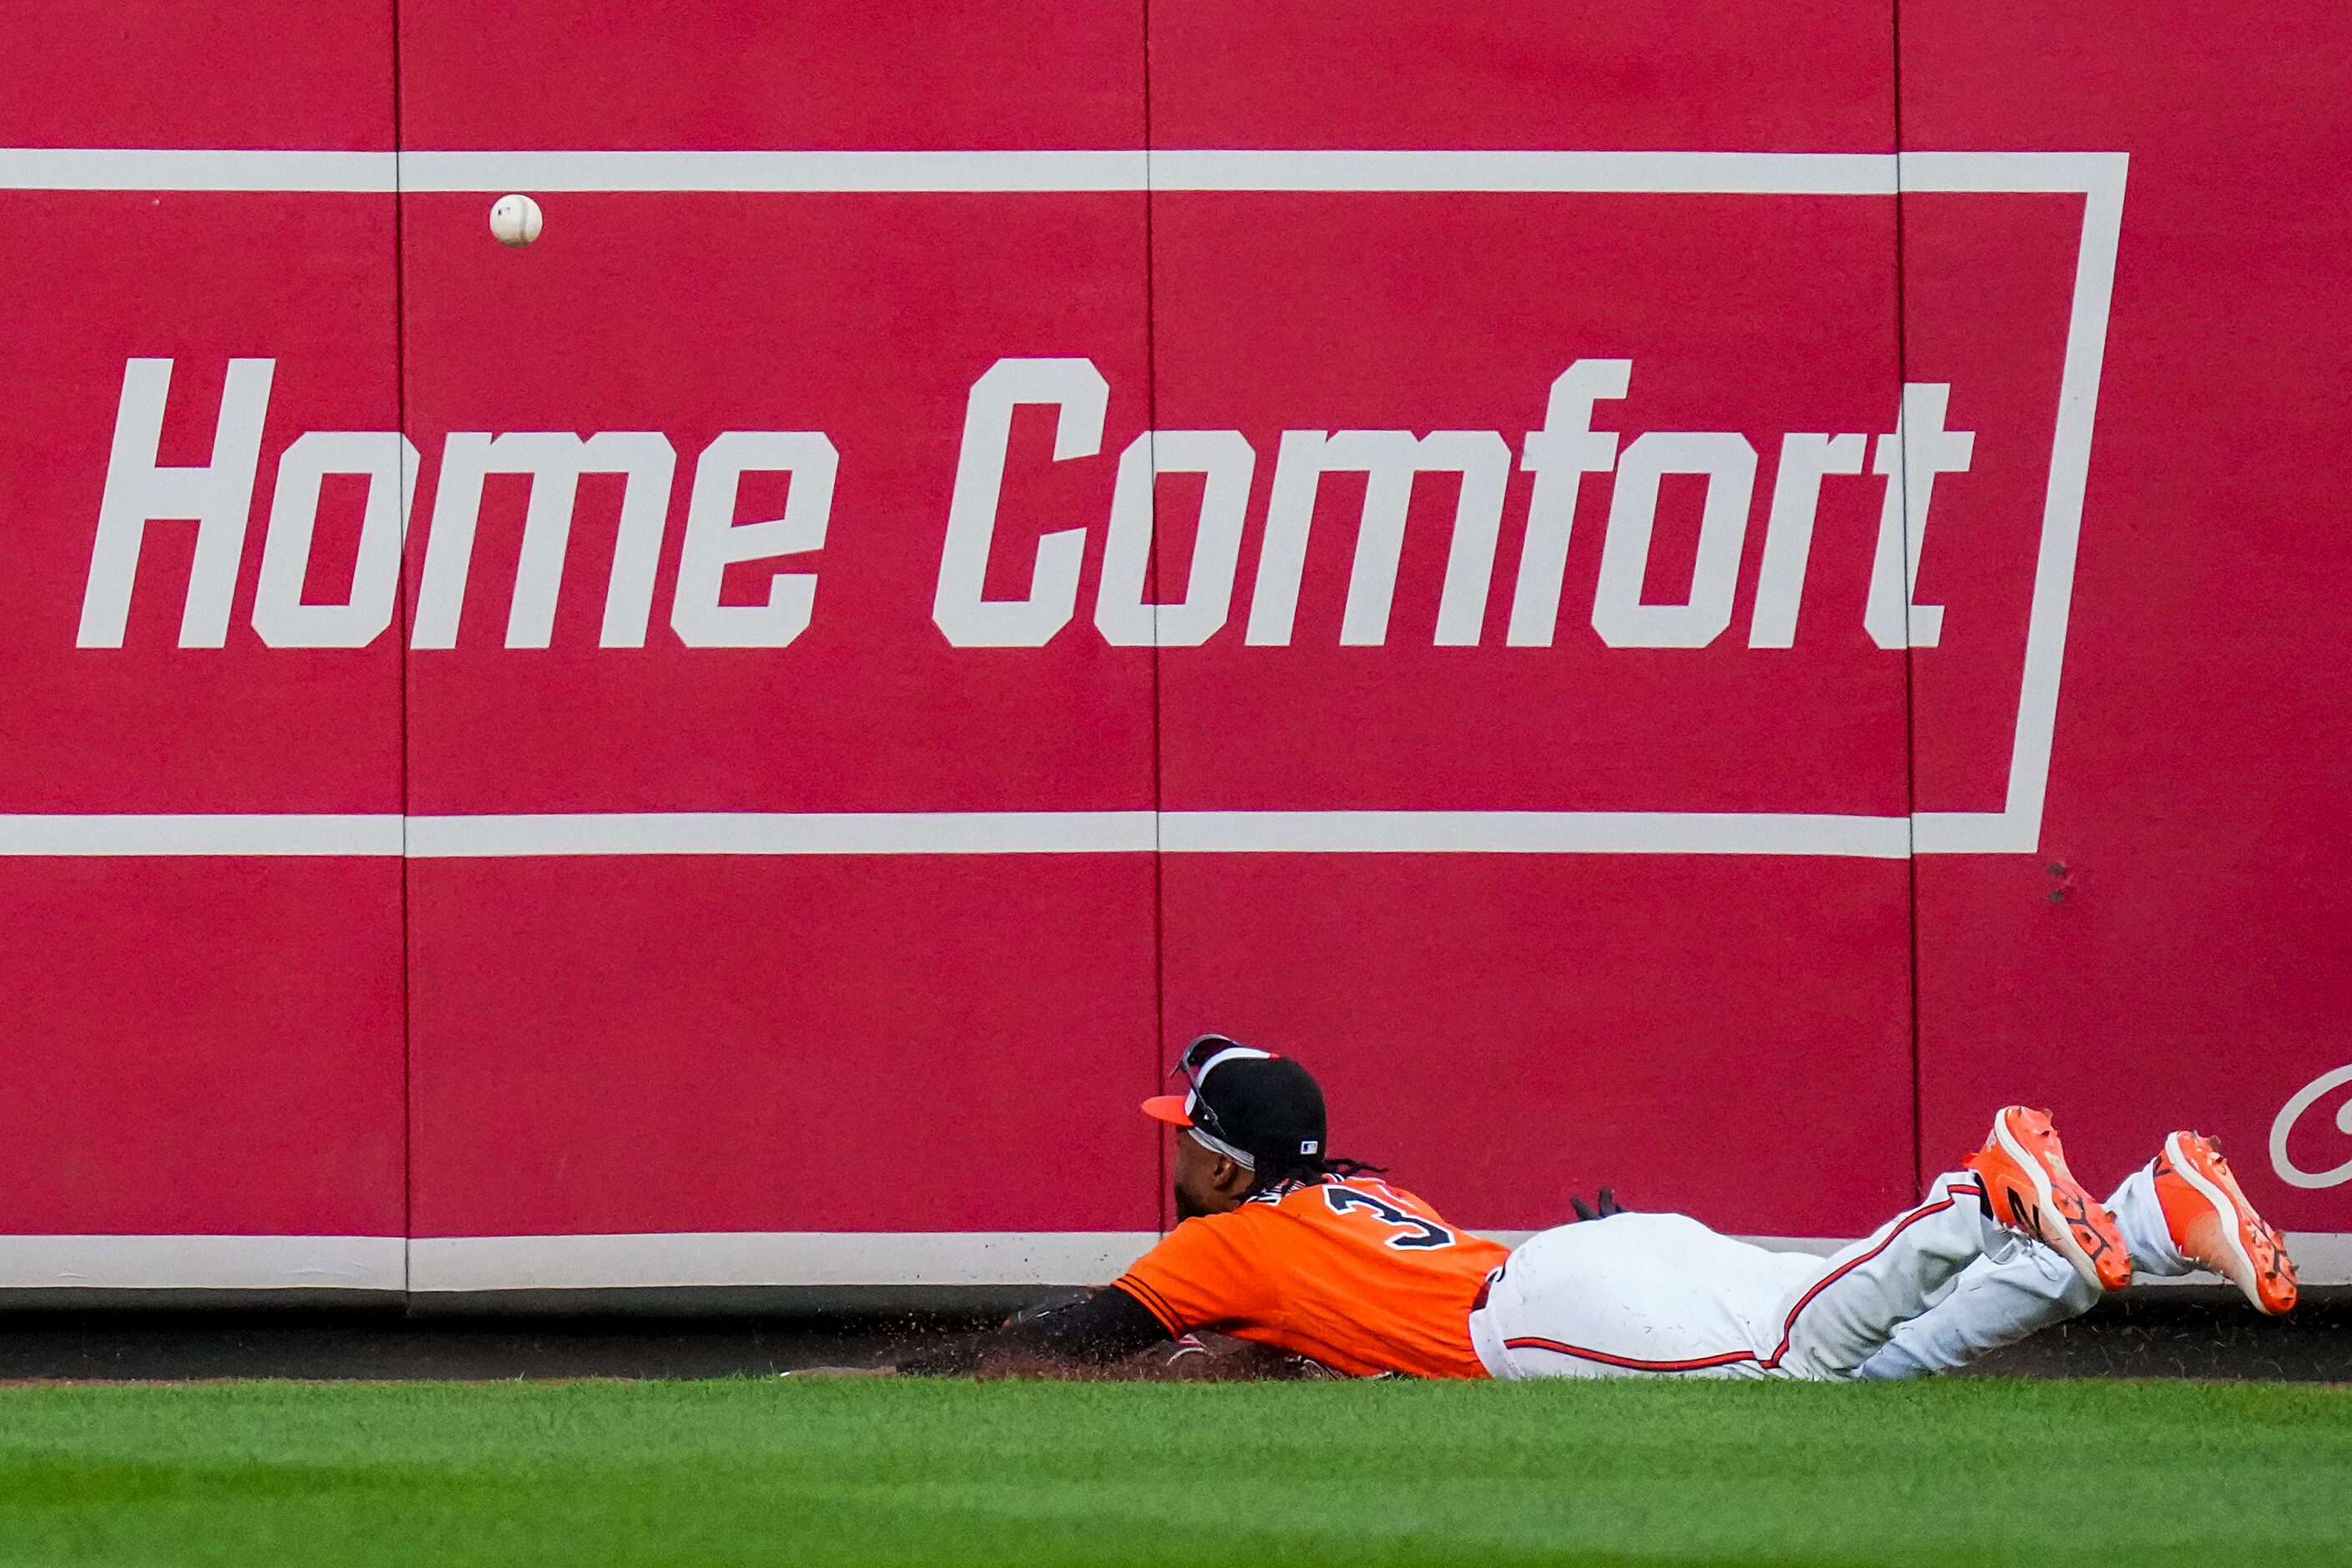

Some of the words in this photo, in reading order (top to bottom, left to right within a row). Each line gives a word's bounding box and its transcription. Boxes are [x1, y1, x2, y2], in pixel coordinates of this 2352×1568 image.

[76, 357, 840, 650] Home
[933, 357, 1976, 650] Comfort
[1322, 1183, 1456, 1251] 3
